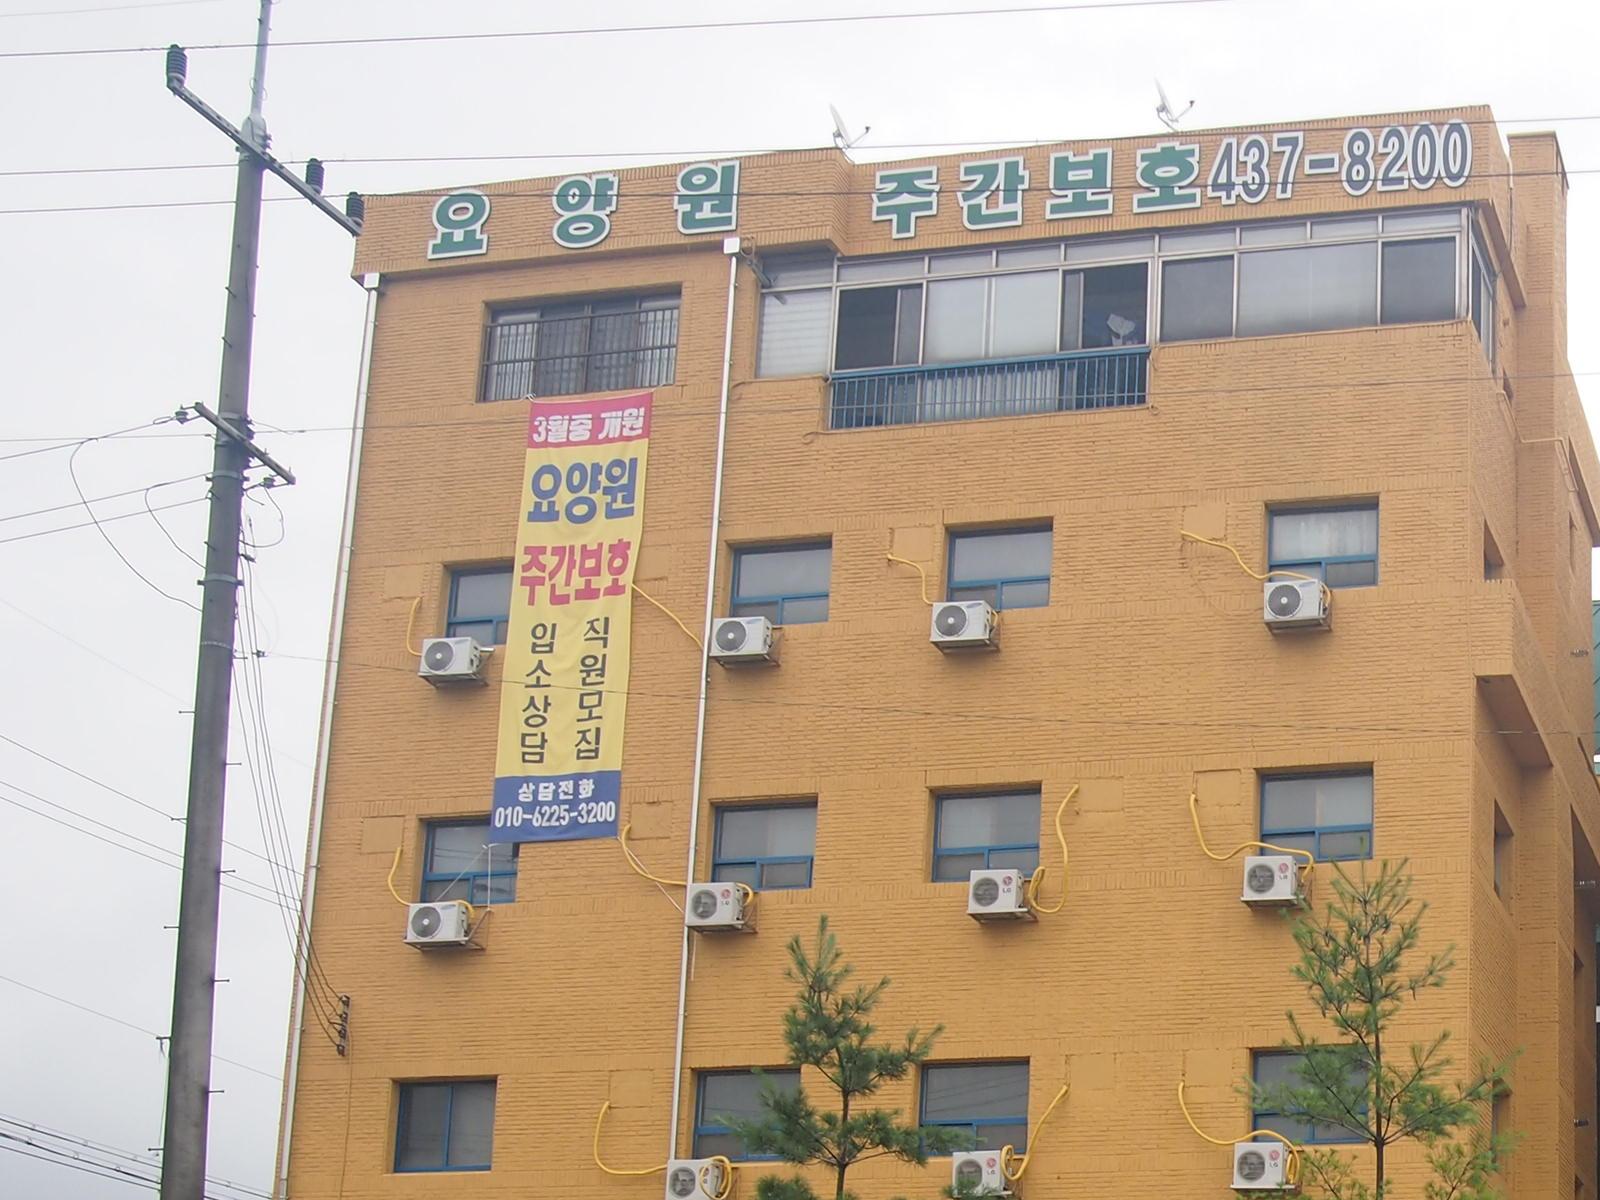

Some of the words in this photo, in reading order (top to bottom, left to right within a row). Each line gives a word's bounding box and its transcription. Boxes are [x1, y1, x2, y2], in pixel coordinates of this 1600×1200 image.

[426, 159, 741, 260] 요양원
[872, 142, 1202, 240] 주간보호
[1207, 119, 1473, 206] 437-8200
[532, 414, 592, 443] 3월중
[597, 407, 645, 439] 개원
[527, 457, 638, 524] 요양원
[519, 538, 633, 607] 주간보호
[520, 622, 557, 764] 입소상담
[574, 616, 610, 761] 직원모집
[495, 801, 616, 828] 010-6225-3200
[518, 778, 595, 802] 상담전화
